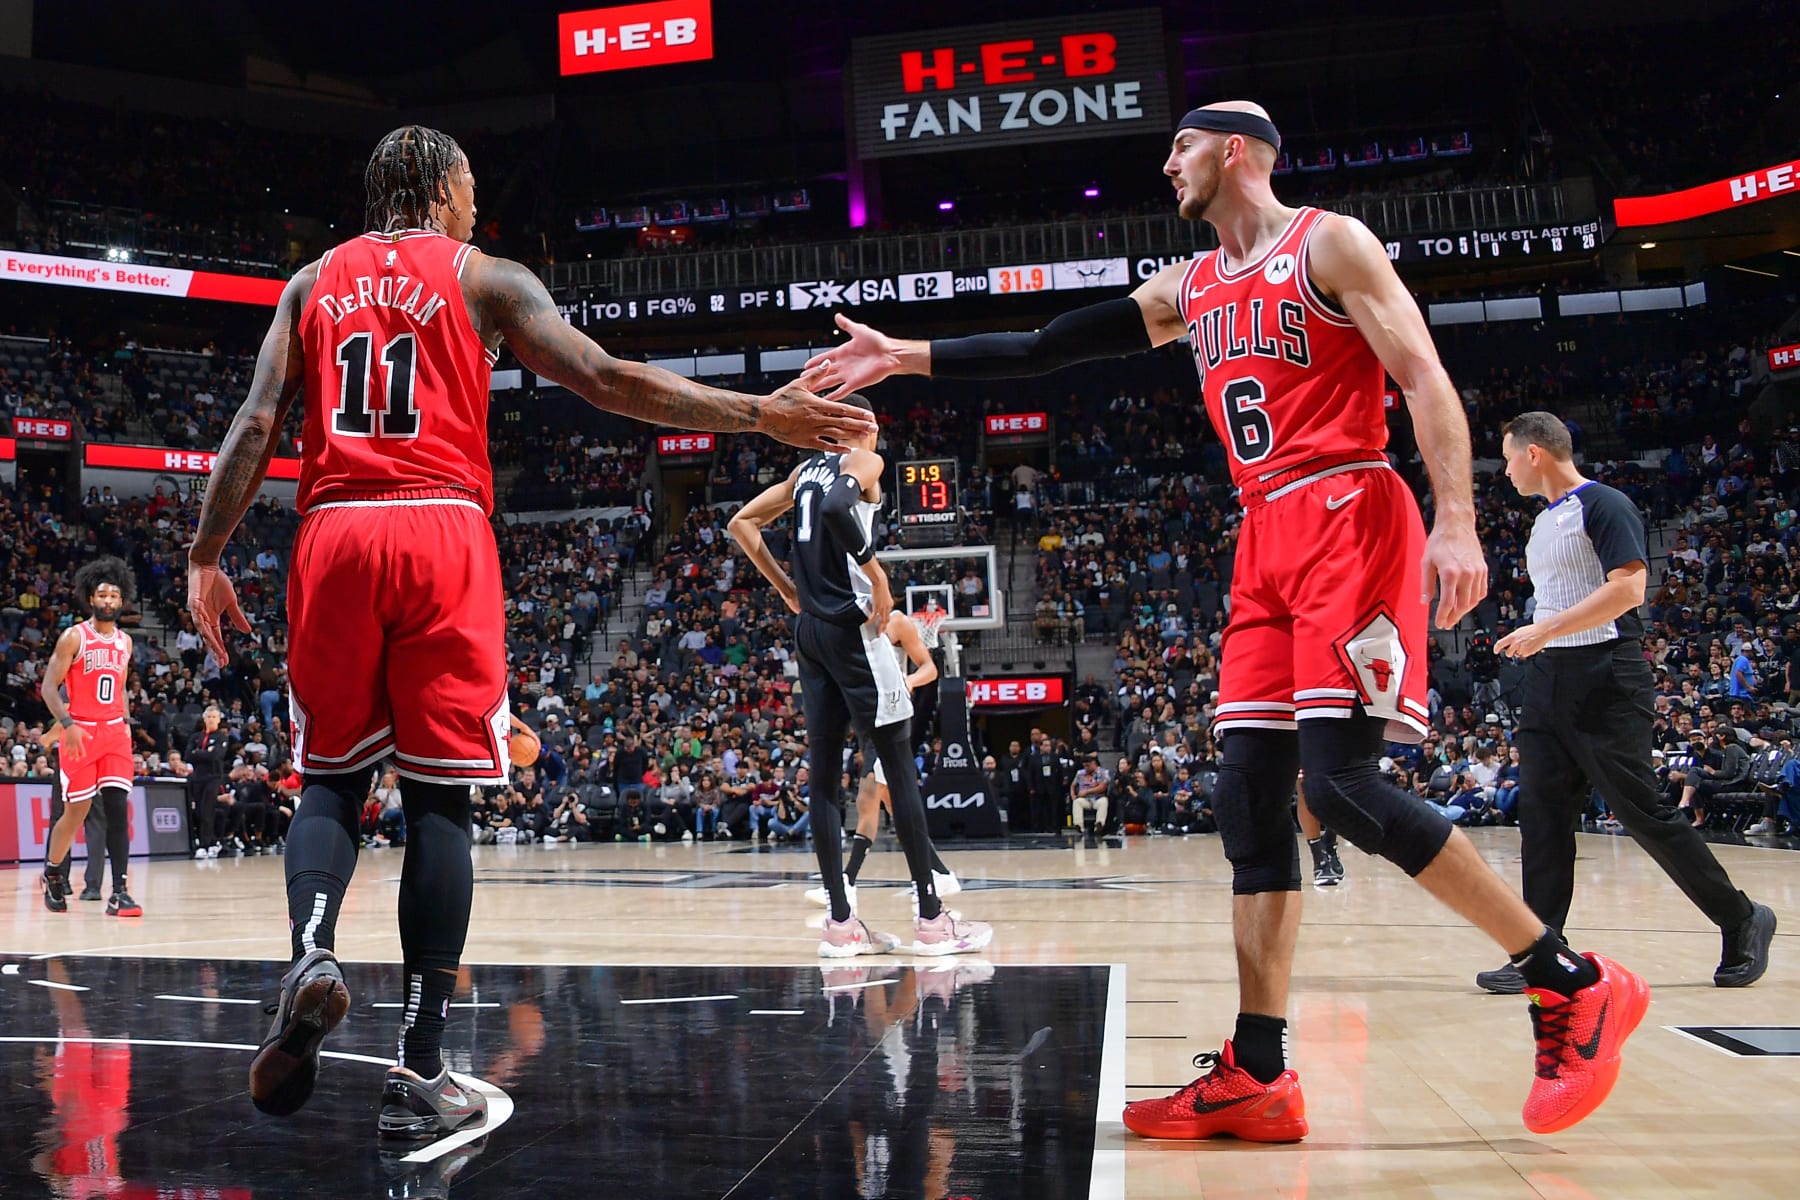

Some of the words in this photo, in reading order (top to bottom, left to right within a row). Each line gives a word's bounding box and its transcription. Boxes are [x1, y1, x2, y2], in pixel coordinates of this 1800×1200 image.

[574, 17, 697, 56] H-E-B
[901, 32, 1117, 93] H-E-B
[880, 96, 982, 141] FAN
[999, 81, 1142, 130] ZONE
[1480, 232, 1507, 243] BLK
[1511, 230, 1538, 241] STL
[1541, 227, 1569, 238] AST
[1573, 222, 1598, 236] REB
[1523, 240, 1530, 254] 4
[1551, 238, 1563, 252] 13
[1583, 234, 1595, 249] 26
[1418, 238, 1453, 256] TO
[1459, 237, 1468, 255] 5
[7, 259, 110, 283] Everything's
[862, 278, 897, 301] SA
[913, 276, 939, 298] 62
[954, 275, 987, 293] 2ND
[999, 268, 1044, 292] 31.9
[591, 303, 621, 319] TO
[628, 301, 637, 318] 5
[647, 297, 696, 316] FG%
[710, 295, 725, 312] 52
[740, 291, 769, 308] PF
[776, 290, 785, 307] 3
[331, 331, 421, 438] 11
[17, 420, 68, 437] H-E-B
[990, 416, 1042, 430] H-E-B
[1221, 375, 1273, 465] 6
[662, 437, 710, 451] H-E-B
[905, 465, 940, 483] 31.9
[921, 481, 948, 510] 13
[798, 490, 814, 542] 1
[97, 674, 115, 704] 0
[973, 683, 1047, 700] H-E-B
[942, 757, 968, 768] Frost
[927, 792, 985, 809] KIA
